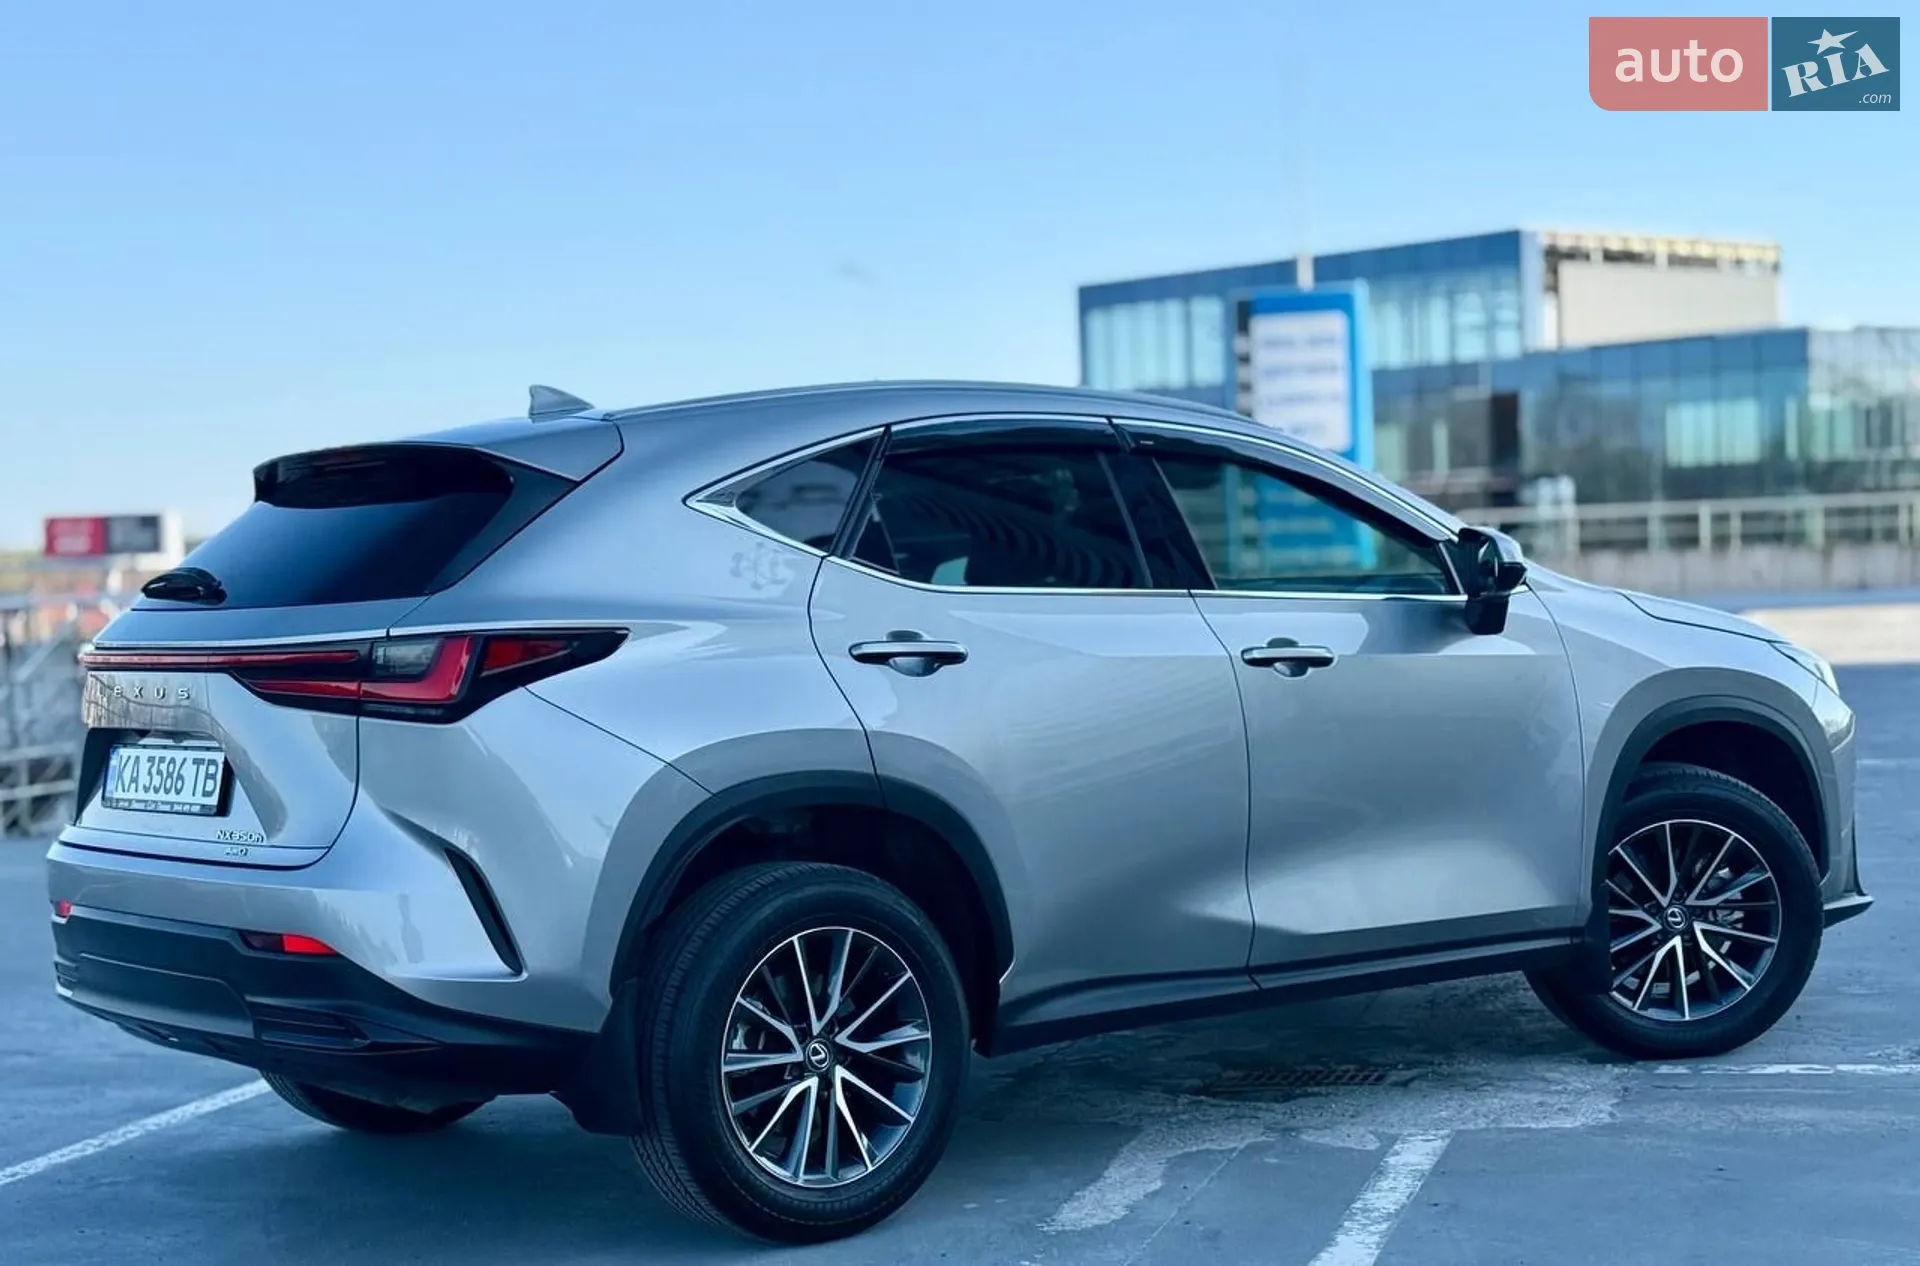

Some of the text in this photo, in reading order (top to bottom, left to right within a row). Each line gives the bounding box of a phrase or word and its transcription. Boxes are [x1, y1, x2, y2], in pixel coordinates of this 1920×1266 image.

[115, 755, 219, 798] KA 3586 TB
